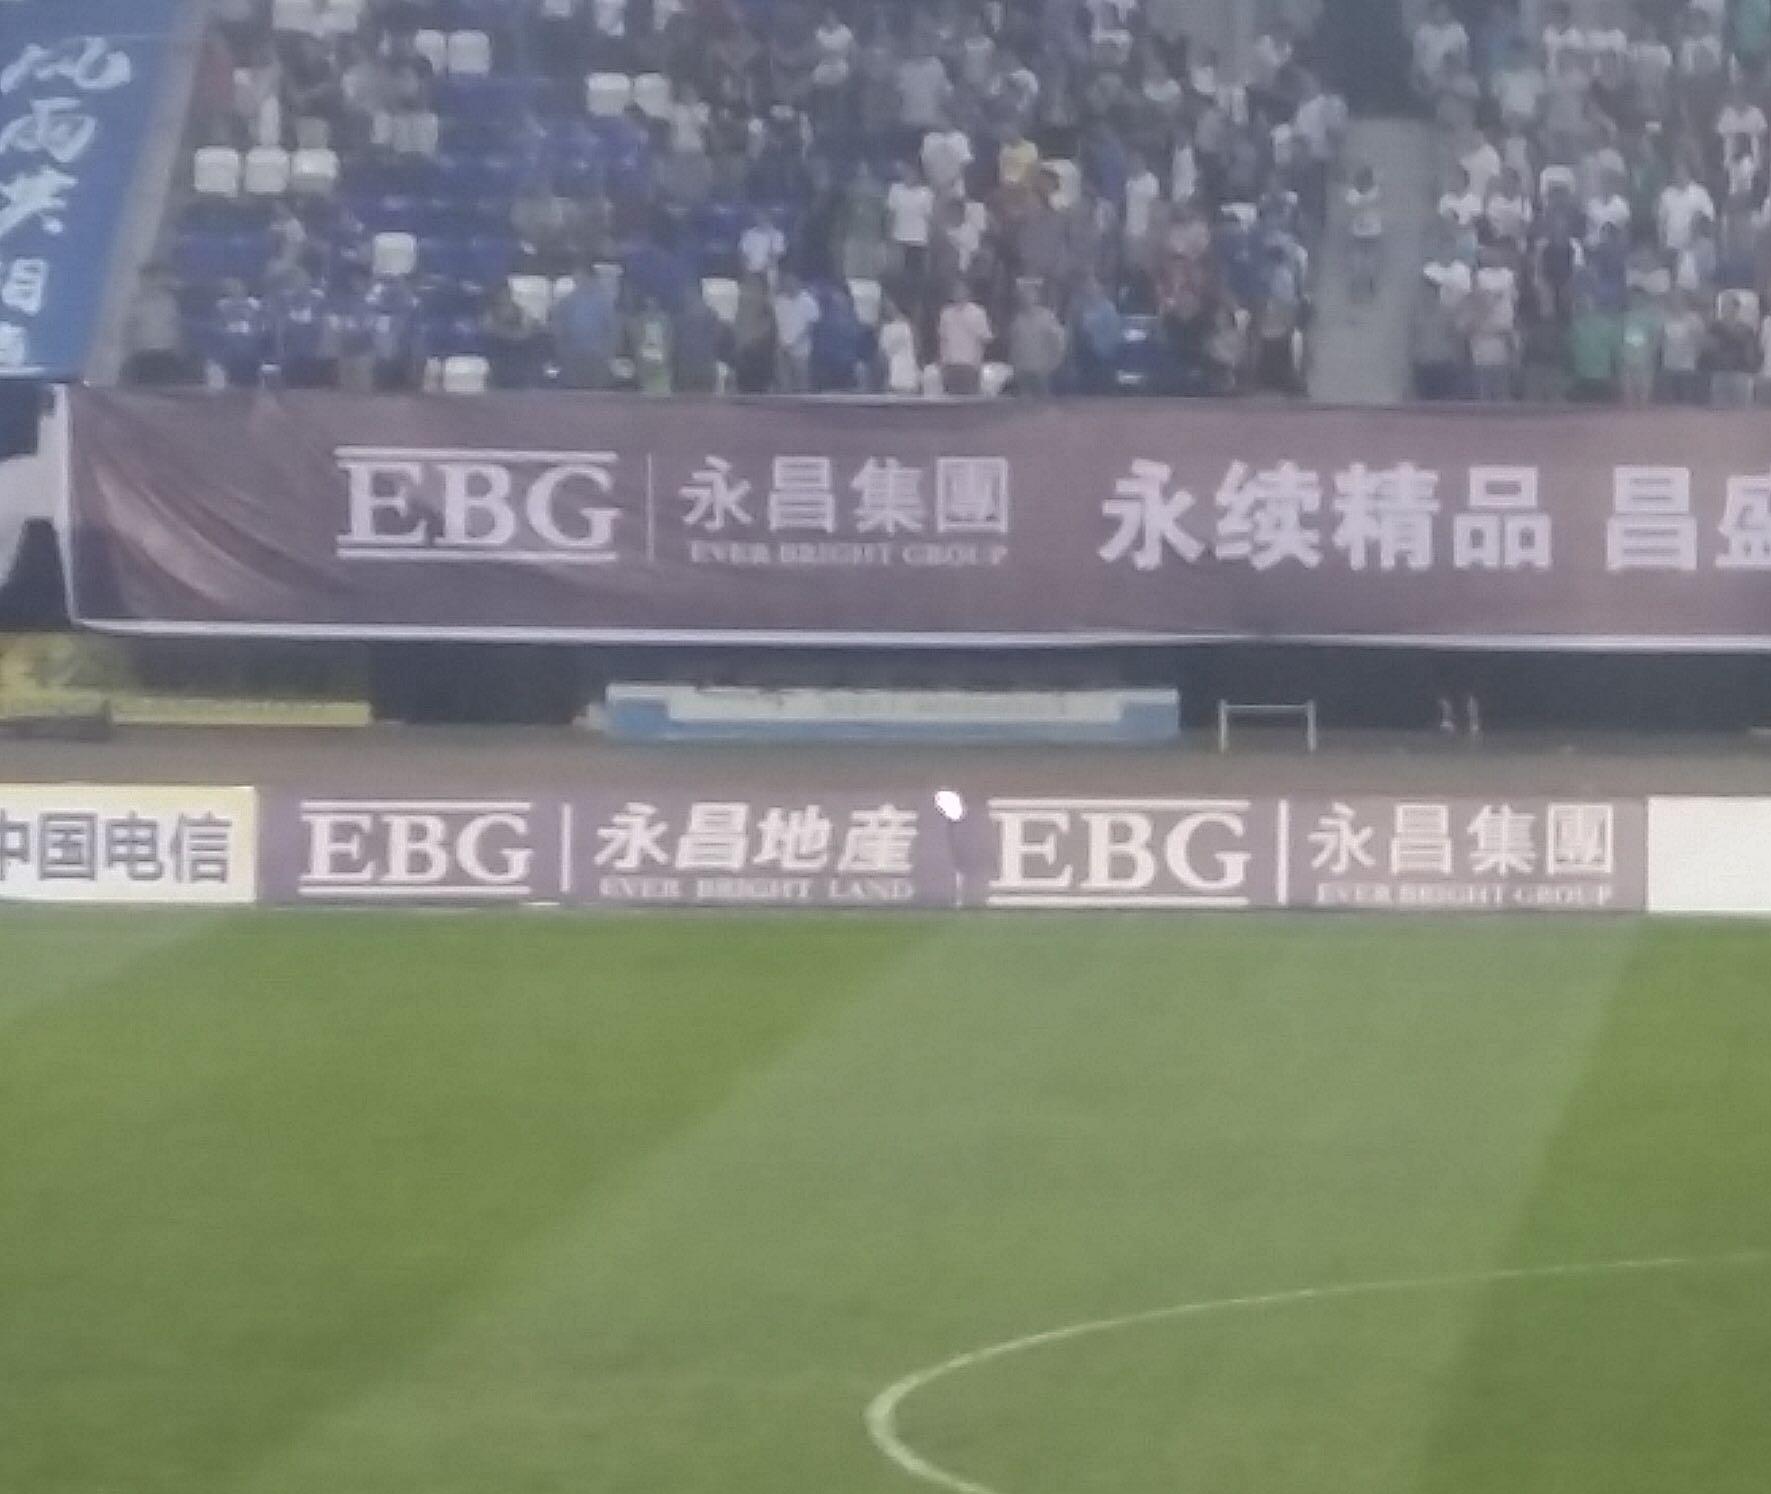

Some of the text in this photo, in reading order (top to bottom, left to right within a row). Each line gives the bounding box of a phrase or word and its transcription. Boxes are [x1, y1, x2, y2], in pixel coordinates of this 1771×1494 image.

[344, 462, 620, 547] EBG
[1098, 458, 1553, 573] 永续精品
[688, 541, 771, 564] EVER
[779, 541, 892, 565] BRIGHT
[0, 808, 232, 885] 中国电信
[302, 816, 534, 884] EBG
[998, 811, 1251, 890] EBG
[599, 877, 916, 899] EVER BRIGHT LAND
